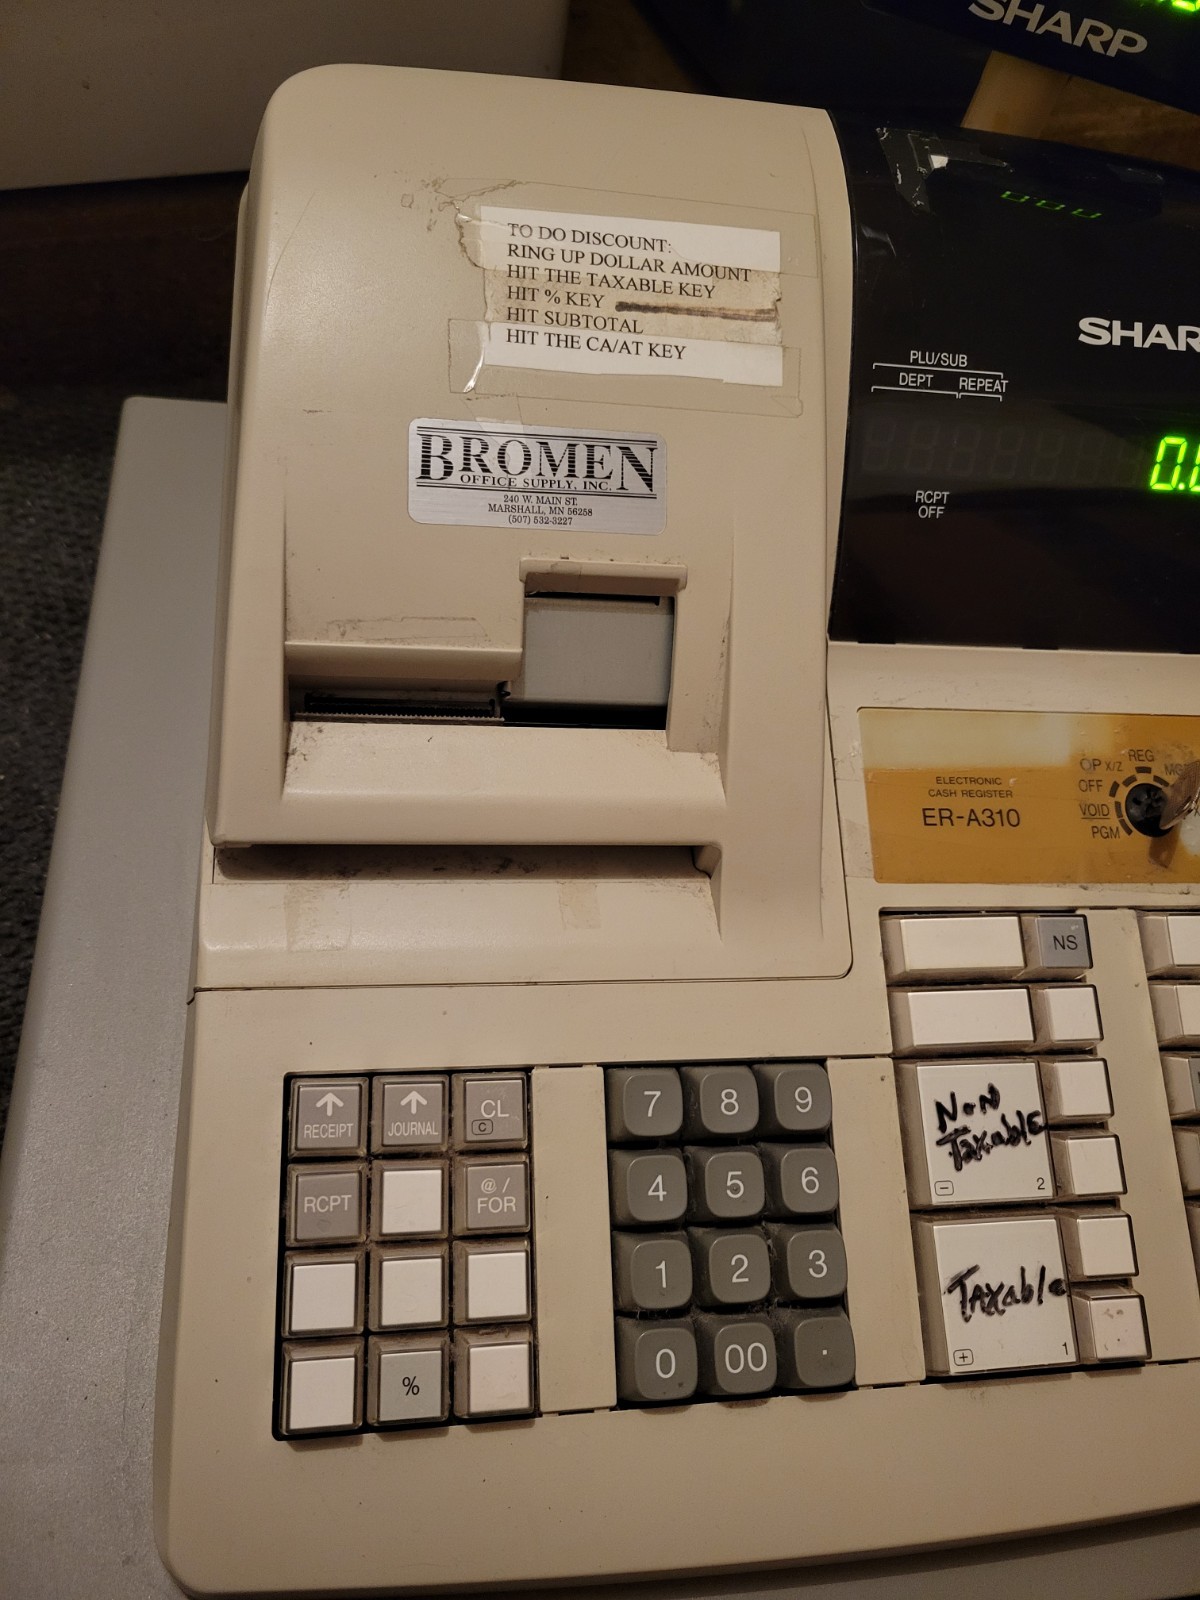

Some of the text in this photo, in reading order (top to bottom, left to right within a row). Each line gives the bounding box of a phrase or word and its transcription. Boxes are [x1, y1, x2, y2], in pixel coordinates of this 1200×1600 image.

[968, 0, 1148, 57] SHARP
[507, 222, 672, 254] TO DO DISCOUNT:
[508, 243, 752, 282] RING UP DOLLAR AMOUNT
[507, 264, 716, 299] HIT THE TAXABLE KEY
[507, 285, 605, 309] HIT % KEY
[507, 306, 644, 335] HIT SUBTOTAL
[506, 328, 687, 360] HIT THE CA/AT KEY
[910, 350, 968, 368] PLU/SUB
[899, 372, 1009, 393] DEPT REPEAT
[416, 433, 658, 492] BROMEN
[460, 473, 613, 492] OFFICE SUPPLY, INC.
[503, 494, 578, 506] 240 W. MAIN ST.
[915, 490, 949, 504] RCPT
[488, 503, 593, 517] MARSHALL, MN 56258
[508, 514, 573, 525] (507) 532-3227
[918, 506, 945, 519] OFF
[1080, 758, 1123, 771] OP X/Z
[1128, 749, 1155, 762] REG
[935, 776, 1002, 785] ELECTRONIC
[1078, 779, 1102, 793] OFF
[928, 789, 1013, 798] CASH REGISTER
[922, 807, 1021, 827] ER-A310
[1080, 803, 1110, 817] VOID
[1091, 825, 1120, 839] PGM
[1053, 935, 1078, 951] NS
[643, 1091, 661, 1117] 7
[720, 1089, 739, 1115] 8
[794, 1086, 813, 1113] 9
[480, 1100, 510, 1119] CL
[304, 1123, 354, 1139] RECEIPT
[388, 1121, 439, 1137] JOURNAL
[478, 1121, 488, 1133] C
[648, 1174, 667, 1201] 4
[726, 1171, 744, 1198] 5
[801, 1166, 820, 1194] 6
[1036, 1177, 1046, 1190] 2
[304, 1195, 352, 1213] RCPT
[477, 1197, 516, 1214] FOR
[731, 1254, 749, 1283] 2
[808, 1250, 828, 1278] 3
[655, 1260, 667, 1288] 1
[655, 1348, 676, 1379] 0
[724, 1342, 767, 1374] 00
[402, 1376, 420, 1396] %
